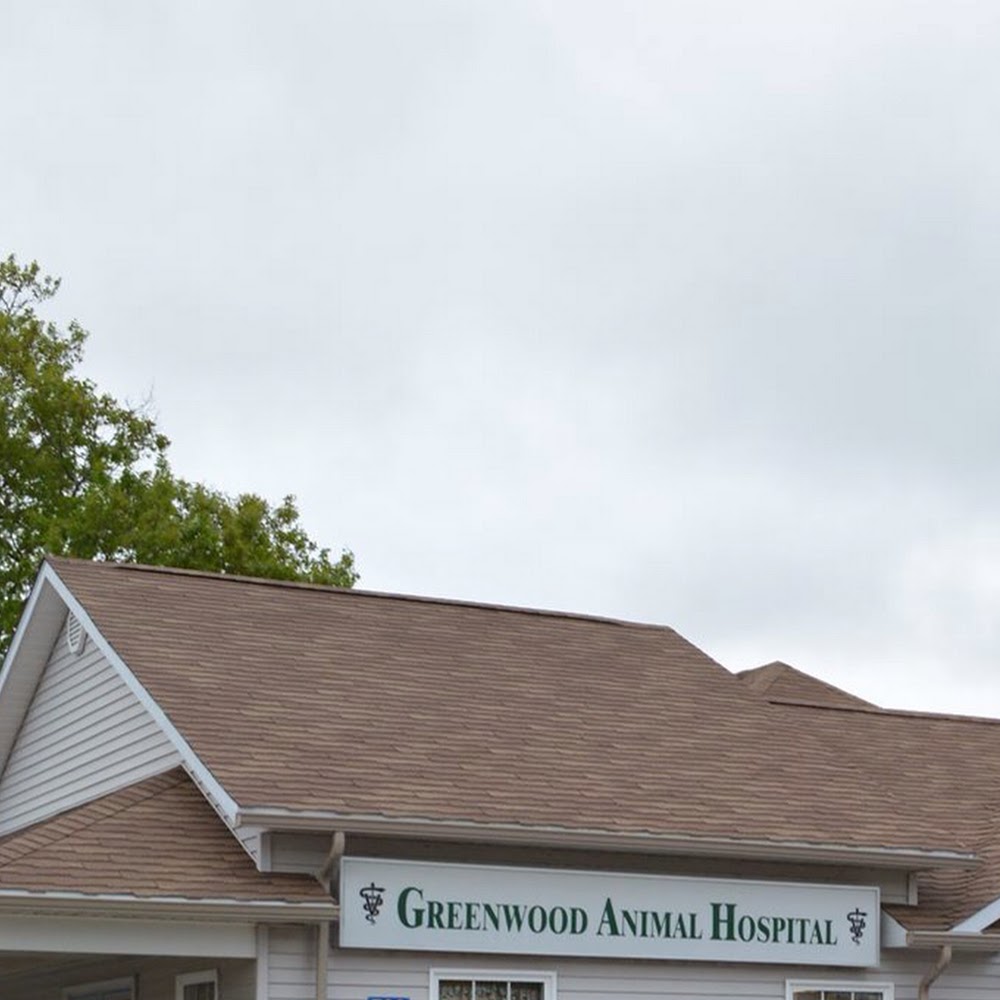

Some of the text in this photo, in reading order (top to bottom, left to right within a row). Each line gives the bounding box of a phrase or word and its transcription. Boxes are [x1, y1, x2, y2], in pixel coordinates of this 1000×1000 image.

[397, 886, 838, 946] GREENWOOD ANIMAL HOSPITAL
